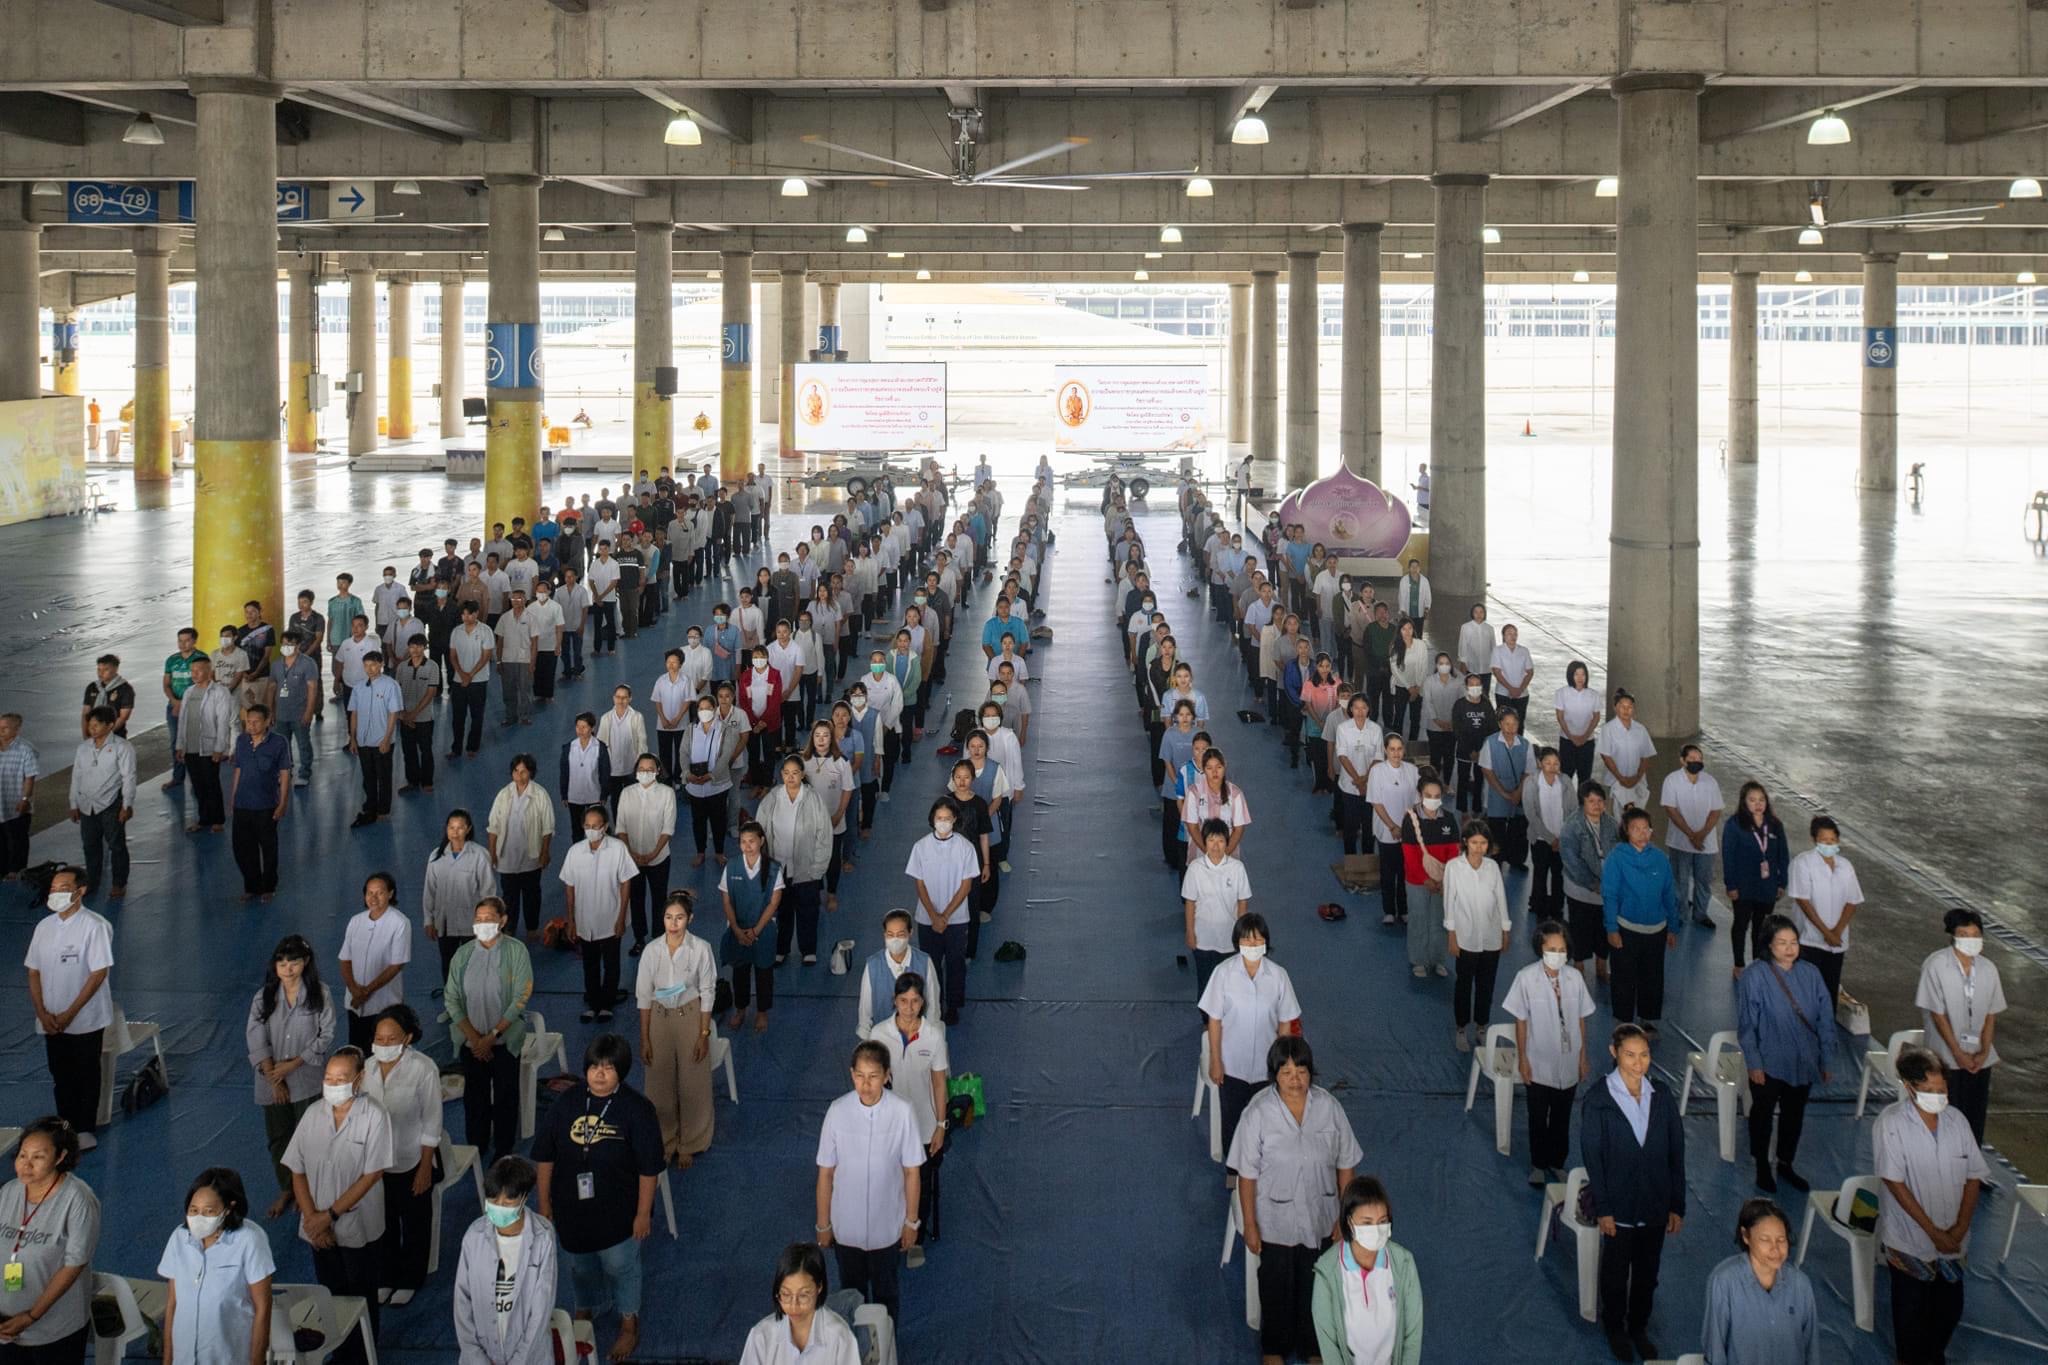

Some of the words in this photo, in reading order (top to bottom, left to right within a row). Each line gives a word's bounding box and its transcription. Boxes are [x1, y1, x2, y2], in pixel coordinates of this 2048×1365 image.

[78, 194, 99, 206] 88
[125, 193, 146, 206] 78
[1875, 331, 1885, 340] E
